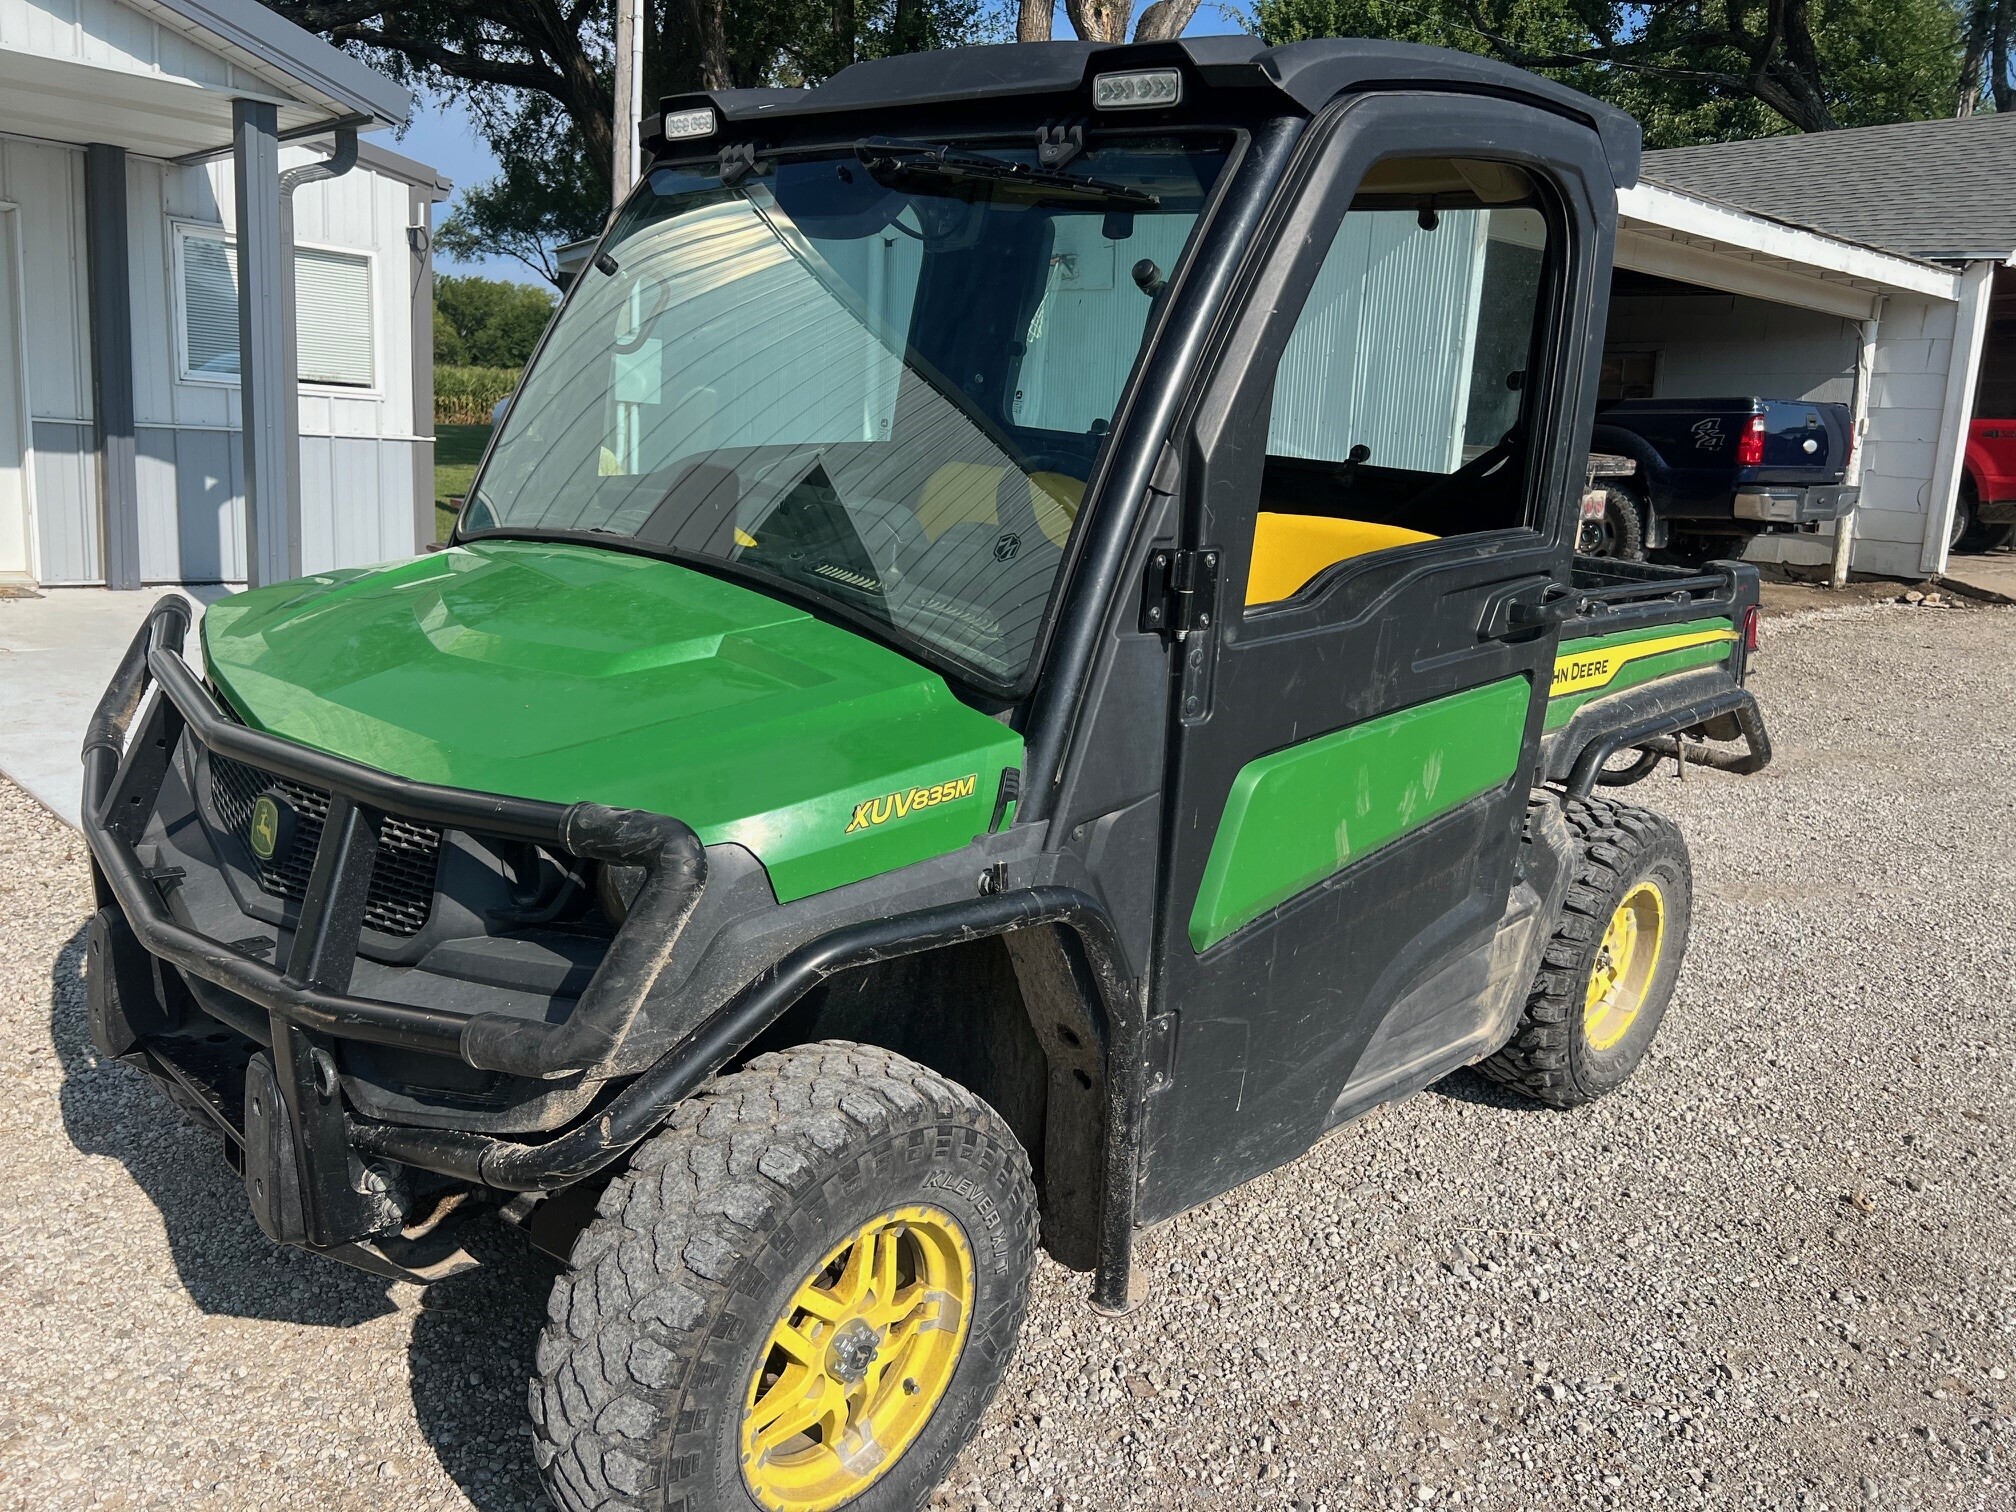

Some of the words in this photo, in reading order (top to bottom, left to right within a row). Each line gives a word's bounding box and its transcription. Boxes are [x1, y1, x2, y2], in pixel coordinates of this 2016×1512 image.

[1552, 667, 1569, 684] HN
[1571, 659, 1609, 680] DEERE
[844, 773, 977, 834] XUV835M
[922, 1170, 1000, 1230] KLEVER
